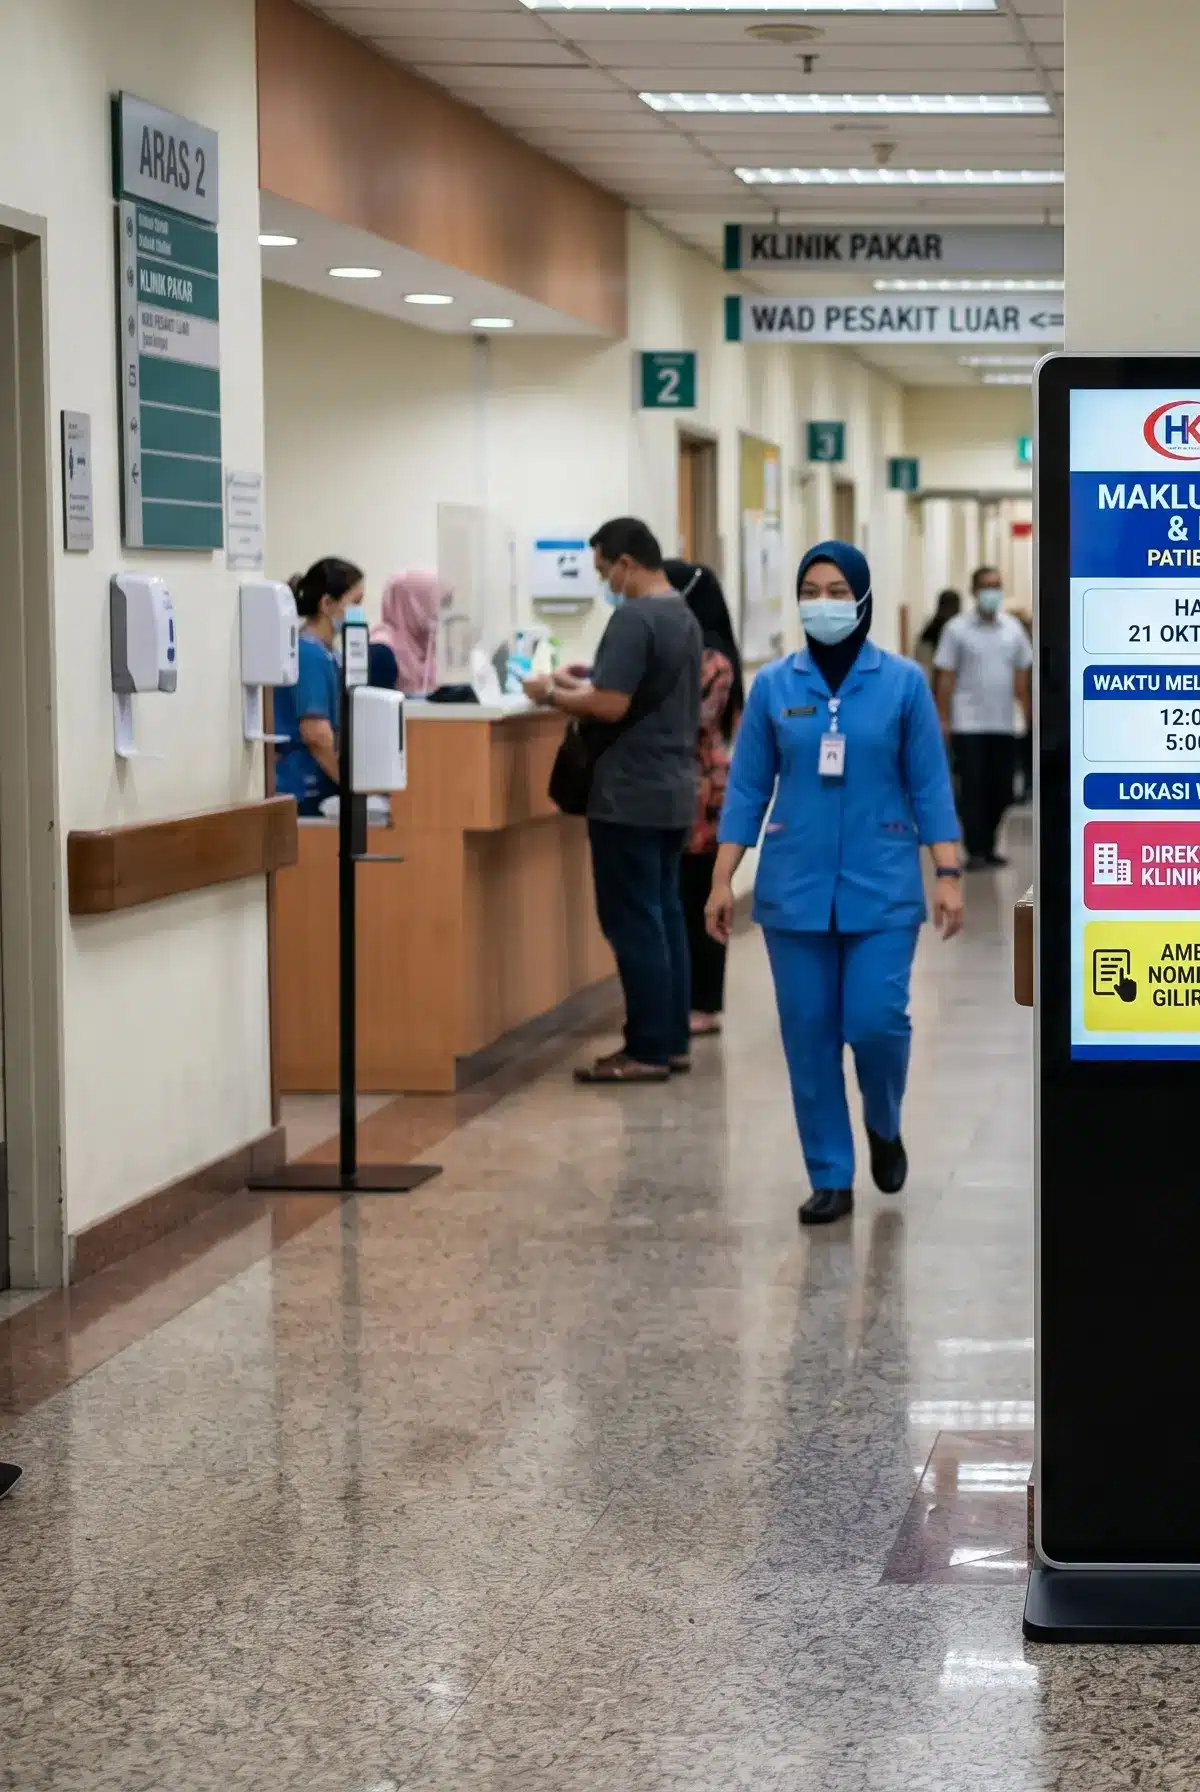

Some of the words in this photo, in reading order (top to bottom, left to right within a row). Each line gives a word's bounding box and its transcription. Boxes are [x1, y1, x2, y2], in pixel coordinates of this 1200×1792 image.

[140, 125, 190, 191] ARAS
[194, 146, 206, 198] 2
[752, 232, 842, 261] KLINIK
[850, 233, 943, 261] PAKAR
[140, 268, 167, 297] KLINIK
[167, 275, 193, 303] PAKAR
[752, 305, 815, 332] WAD
[825, 305, 940, 332] PESAKIT
[950, 305, 1020, 332] LUAR
[656, 369, 681, 403] 2
[1167, 515, 1189, 542] &
[1128, 624, 1152, 643] 21
[1093, 674, 1160, 691] WAKTU
[1119, 782, 1190, 801] LOKASI
